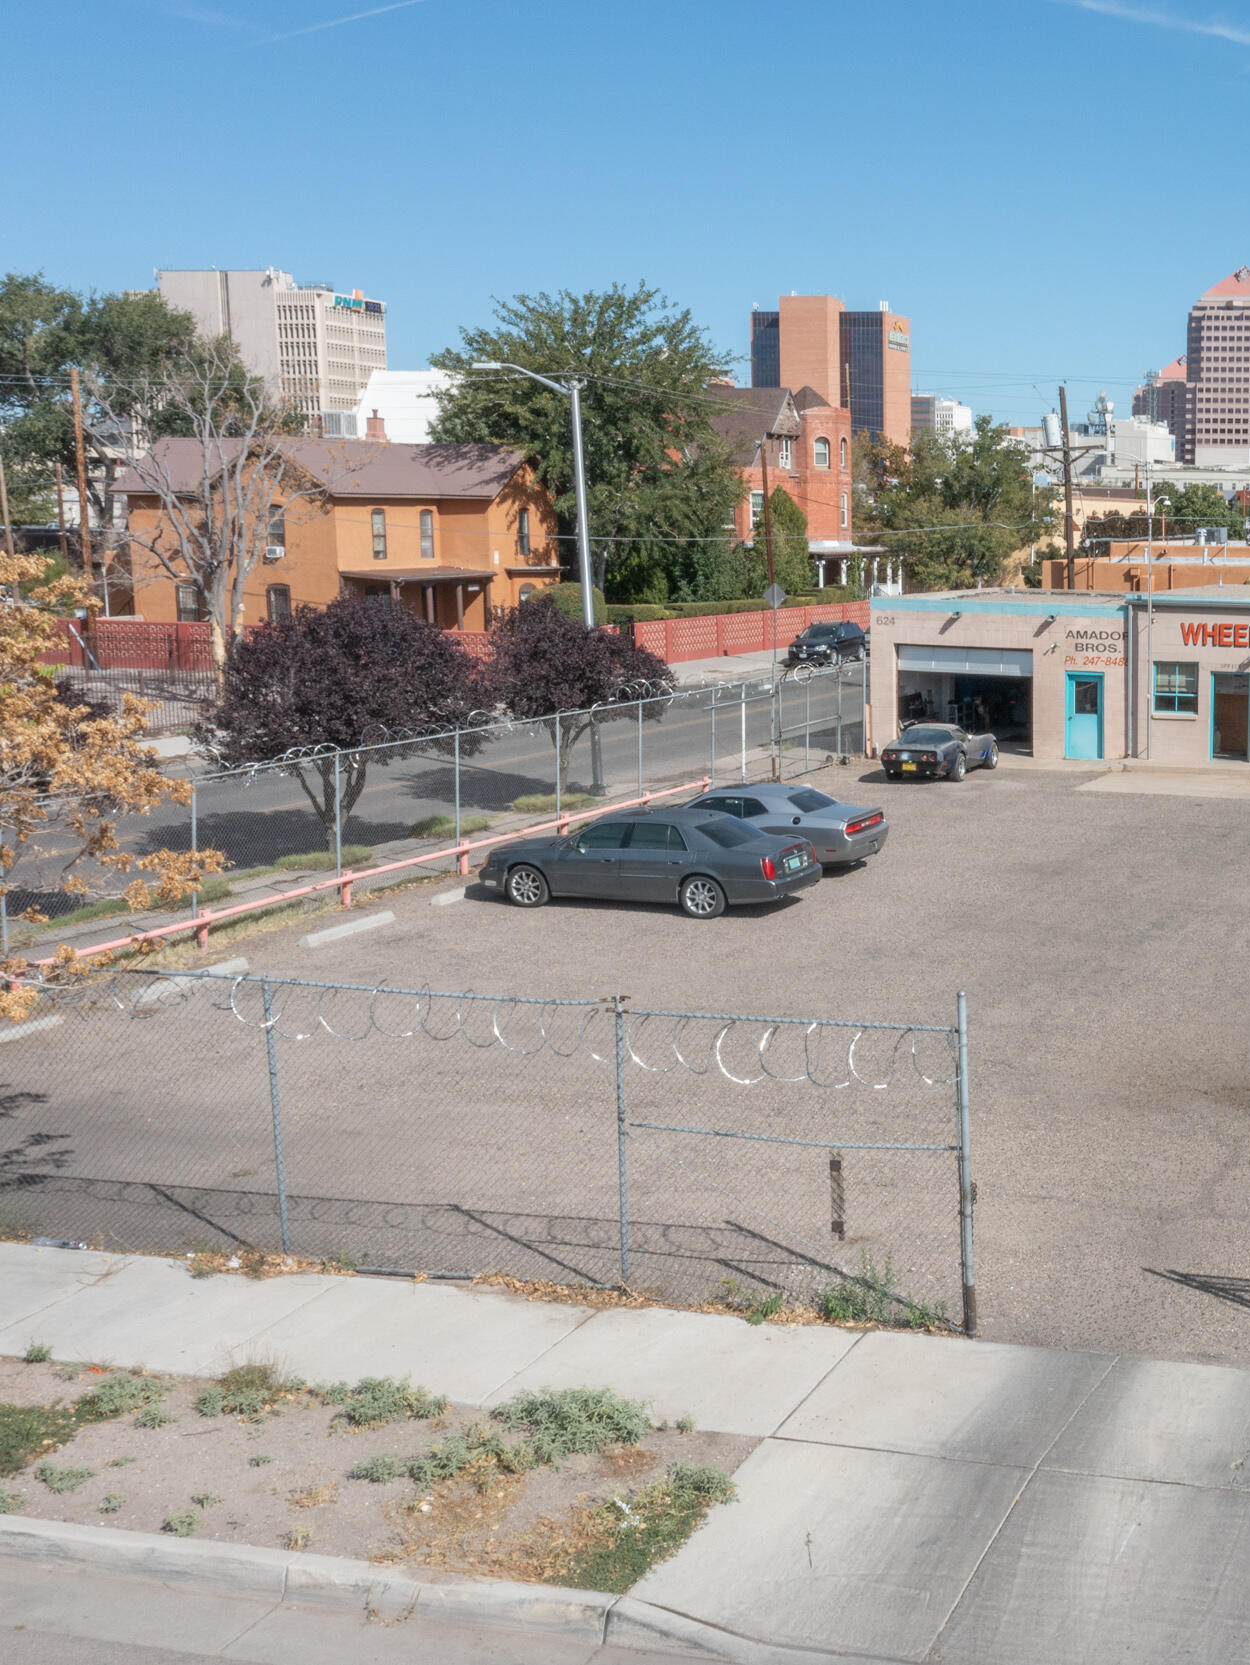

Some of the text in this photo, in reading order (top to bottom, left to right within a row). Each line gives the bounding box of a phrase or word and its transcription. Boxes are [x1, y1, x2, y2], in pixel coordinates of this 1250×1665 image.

[334, 295, 363, 309] PNM
[876, 615, 896, 626] 624
[1074, 643, 1122, 654] BROS.
[1064, 655, 1078, 665] Ph.
